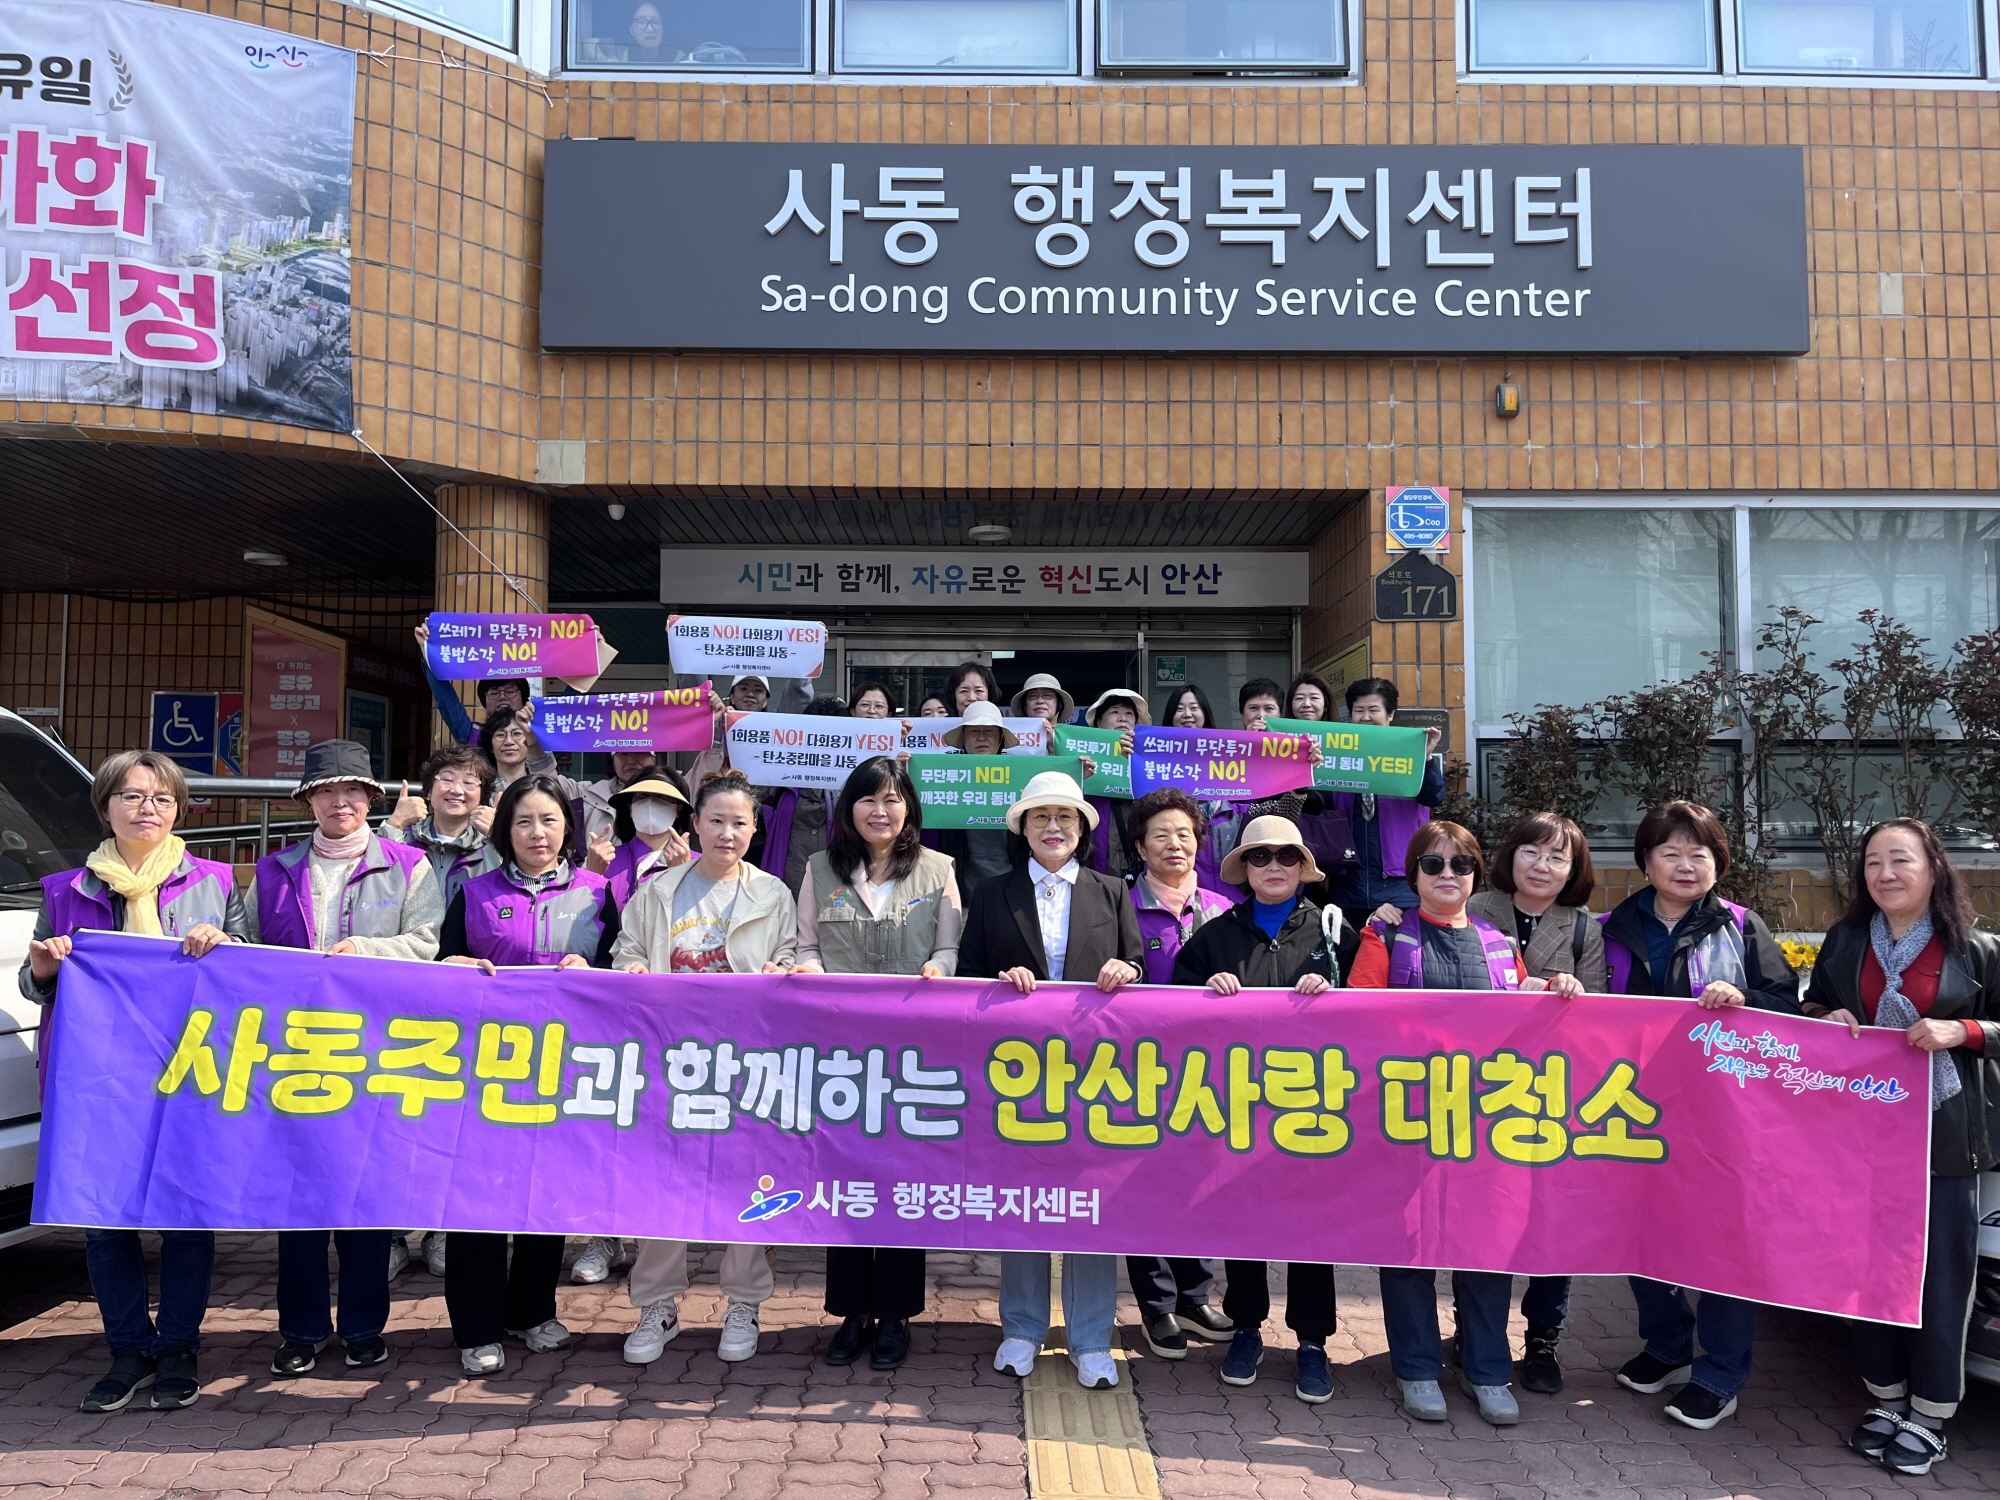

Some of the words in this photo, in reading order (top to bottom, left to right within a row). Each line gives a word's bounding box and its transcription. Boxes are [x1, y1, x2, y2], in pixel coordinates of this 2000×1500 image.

[764, 162, 960, 267] 사동
[1010, 164, 1594, 270] 행정복지센터
[9, 257, 217, 363] 선정
[759, 274, 950, 325] Sa-dong
[966, 275, 1239, 325] Community
[1254, 277, 1417, 319] Service
[1433, 279, 1591, 319] Center
[737, 562, 823, 593] 시민과
[836, 563, 901, 594] 함께,
[911, 564, 1026, 594] 자유로운
[1038, 564, 1149, 595] 혁신도시
[1160, 563, 1222, 595] 안산
[1401, 585, 1453, 616] 171
[438, 622, 482, 639] 쓰레기
[489, 623, 542, 641] 무단투기
[550, 619, 585, 639] NO!
[674, 625, 710, 638] 1회용품
[713, 625, 740, 640] NO!
[742, 629, 783, 642] 다회용기
[787, 628, 820, 643] YES!
[440, 645, 495, 663] 불법소각
[502, 642, 537, 661] NO!
[704, 644, 766, 658] 탄소중립마을
[768, 646, 789, 659] 사동
[279, 674, 313, 691] 공유
[1168, 673, 1185, 681] AED
[269, 694, 321, 711] 냉장고
[664, 688, 701, 707] NO!
[544, 712, 604, 734] 불법소각
[611, 709, 649, 733] NO!
[277, 730, 311, 747] 공유
[731, 729, 770, 744] 1회용품
[773, 728, 804, 746] NO!
[807, 734, 852, 749] 다회용기
[856, 734, 895, 752] YES!
[1065, 738, 1111, 756] 무단투기
[1143, 736, 1188, 755] 쓰레기
[1196, 738, 1253, 757] 무단투기
[1261, 737, 1300, 760] NO!
[1325, 732, 1359, 751] NO!
[763, 751, 832, 768] 탄소중립마을
[833, 755, 857, 770] 사동
[1101, 762, 1123, 777] 우리
[1339, 757, 1363, 771] 동네
[1367, 755, 1413, 775] YES!
[920, 769, 971, 784] 무단투기
[975, 766, 1011, 785] NO!
[1144, 760, 1202, 781] 불법소각
[1209, 760, 1246, 783] NO!
[920, 790, 959, 807] 깨끗한
[962, 791, 987, 806] 우리
[991, 791, 1016, 807] 동네
[1689, 1019, 1755, 1057] 시민과
[158, 1006, 646, 1129] 사동주민과
[666, 1040, 967, 1138] 함께하는
[987, 1037, 1353, 1155] 안산사랑
[1378, 1052, 1667, 1163] 대청소
[1707, 1054, 1771, 1089] 자유로운
[1773, 1063, 1847, 1096] 혁신도시
[1850, 1074, 1910, 1103] 안산
[806, 1179, 878, 1221] 사동
[891, 1179, 1101, 1226] 행정복지센터
